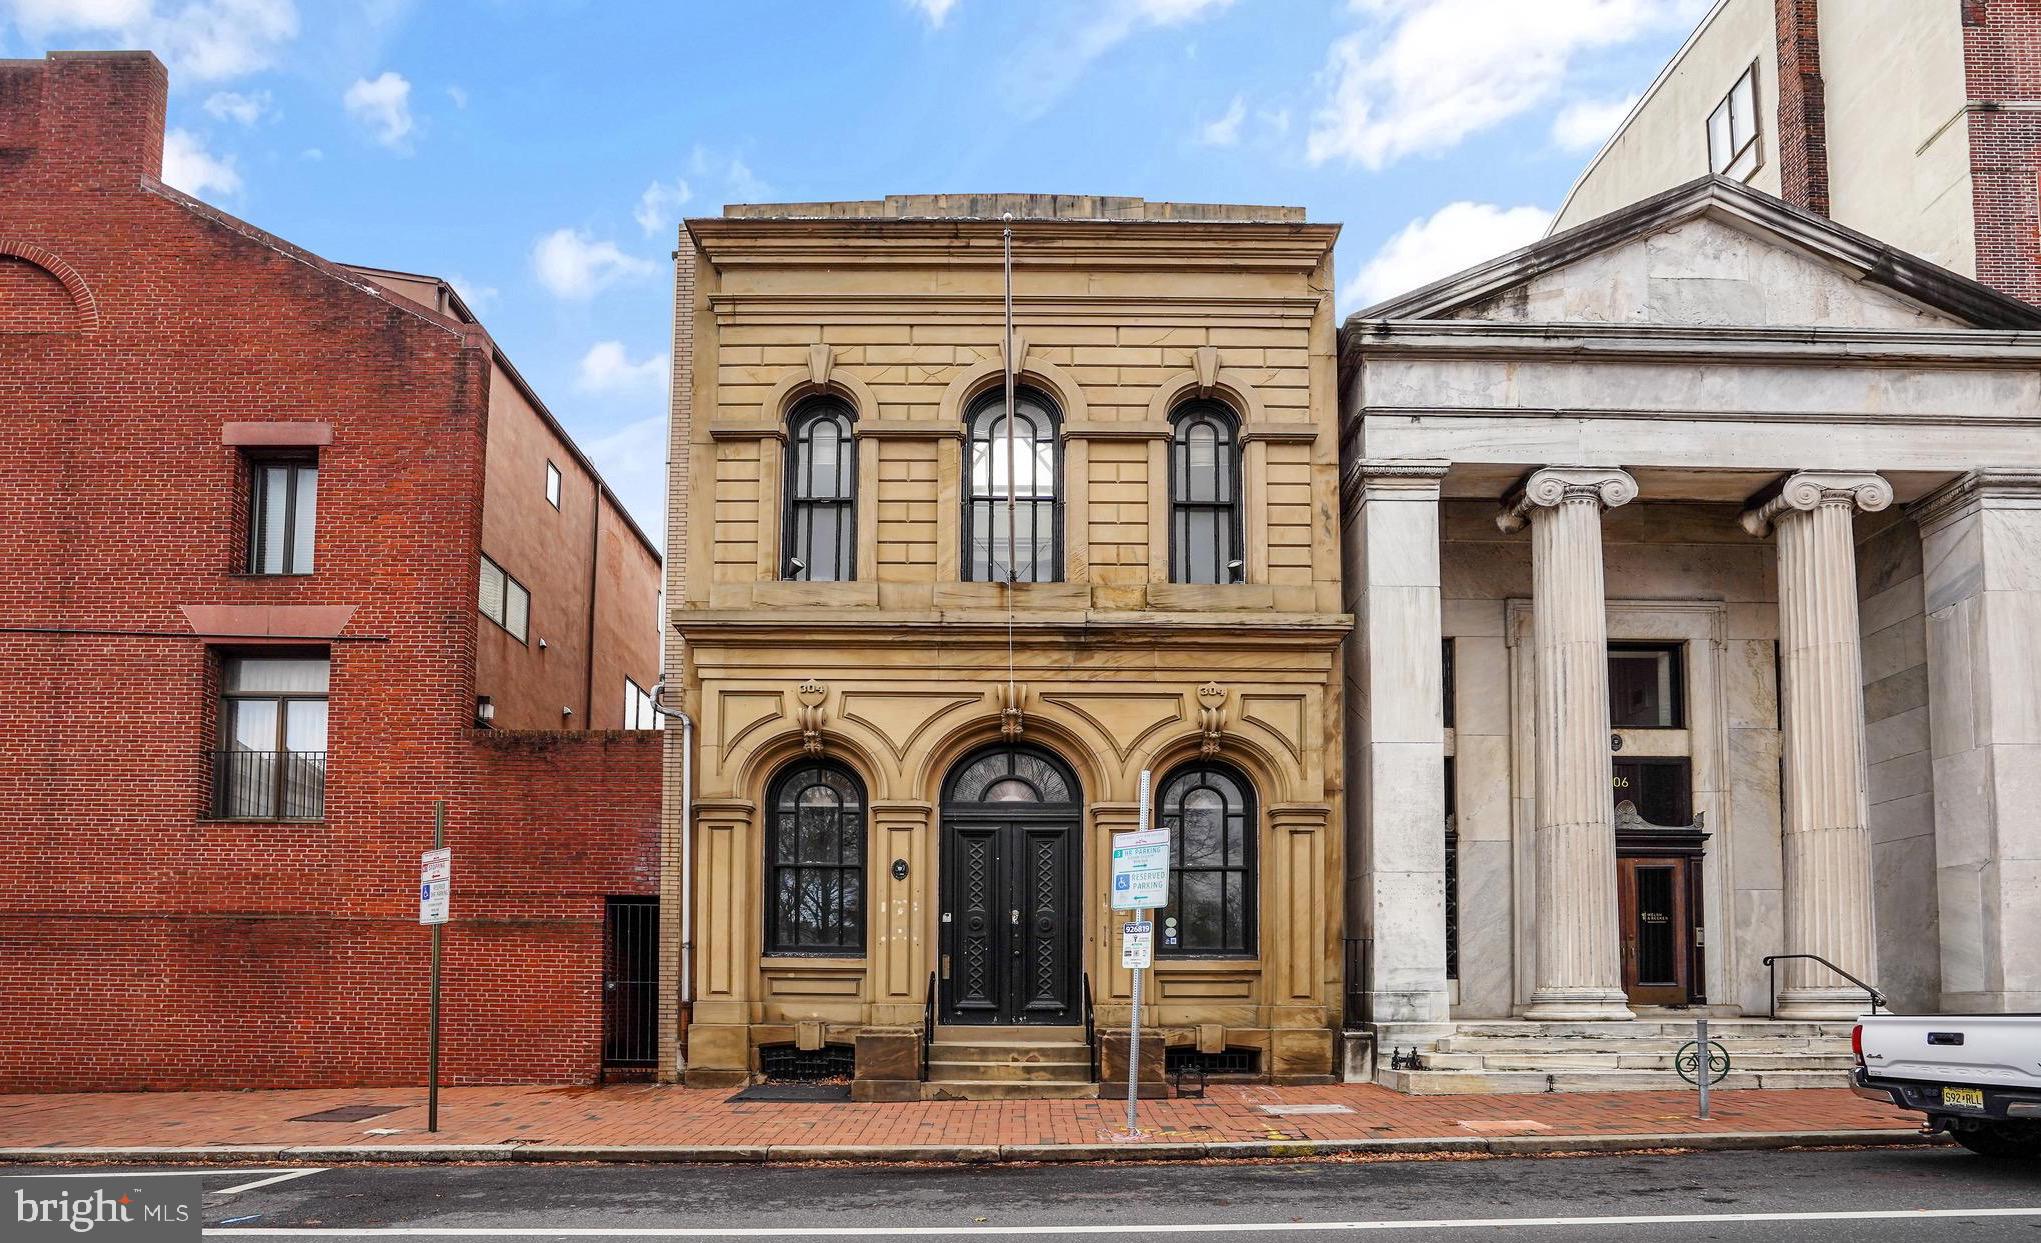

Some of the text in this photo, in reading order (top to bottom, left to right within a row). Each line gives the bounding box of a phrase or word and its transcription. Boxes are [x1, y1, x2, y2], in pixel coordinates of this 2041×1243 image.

[800, 685, 825, 694] 304
[1200, 687, 1225, 696] 304
[1135, 847, 1161, 855] PARKING
[1131, 871, 1165, 881] RESERVED
[1133, 881, 1163, 890] PARKING
[1125, 925, 1150, 933] 926819
